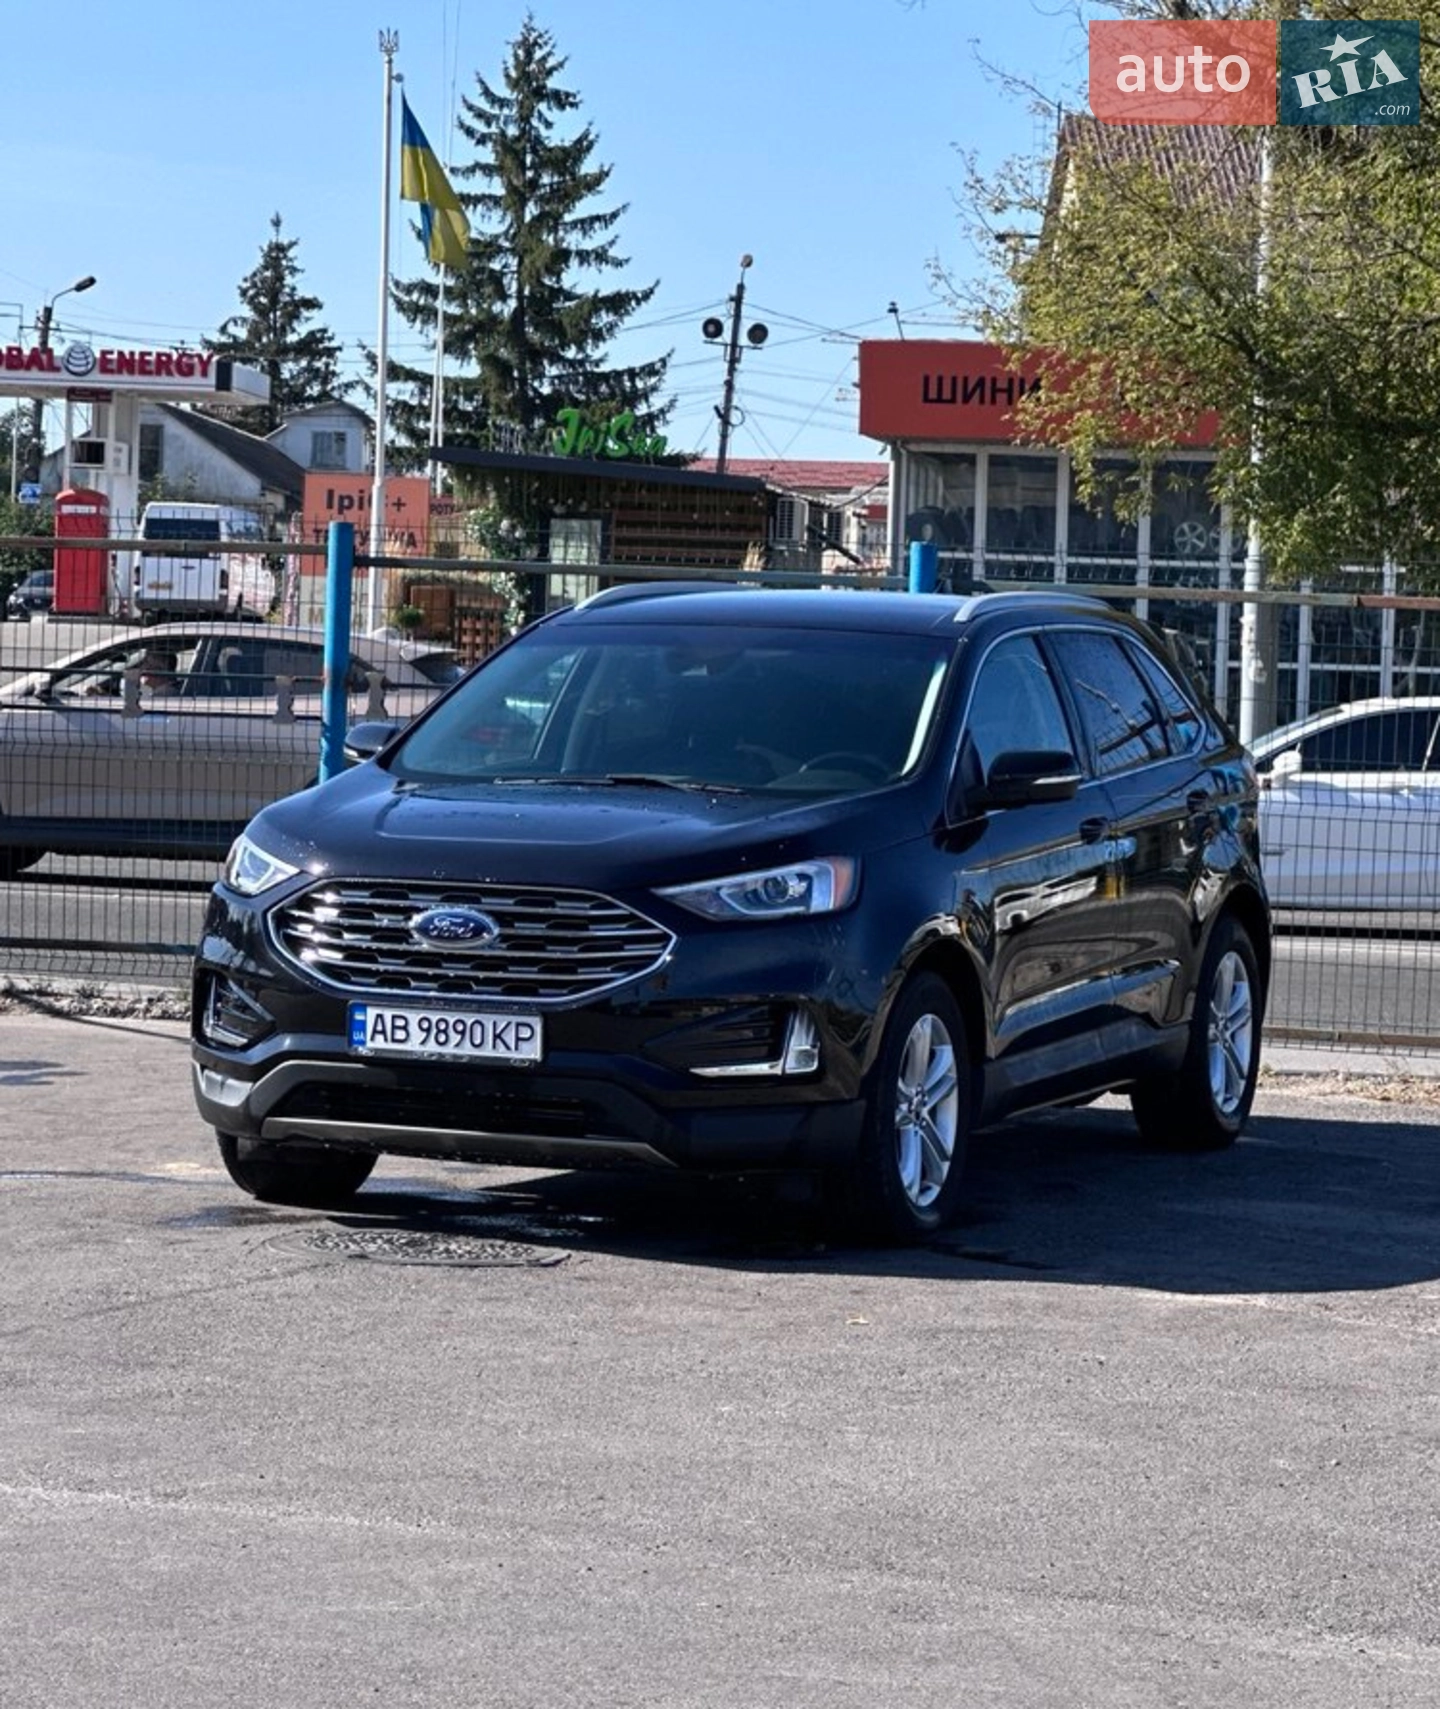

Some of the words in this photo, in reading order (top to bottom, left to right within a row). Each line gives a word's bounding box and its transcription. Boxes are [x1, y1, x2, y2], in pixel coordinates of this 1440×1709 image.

[0, 346, 61, 373] BAL
[98, 350, 214, 378] ENERGY
[429, 915, 476, 938] Ford
[370, 1013, 410, 1044] AB
[418, 1016, 485, 1048] 9890
[492, 1020, 535, 1051] KP
